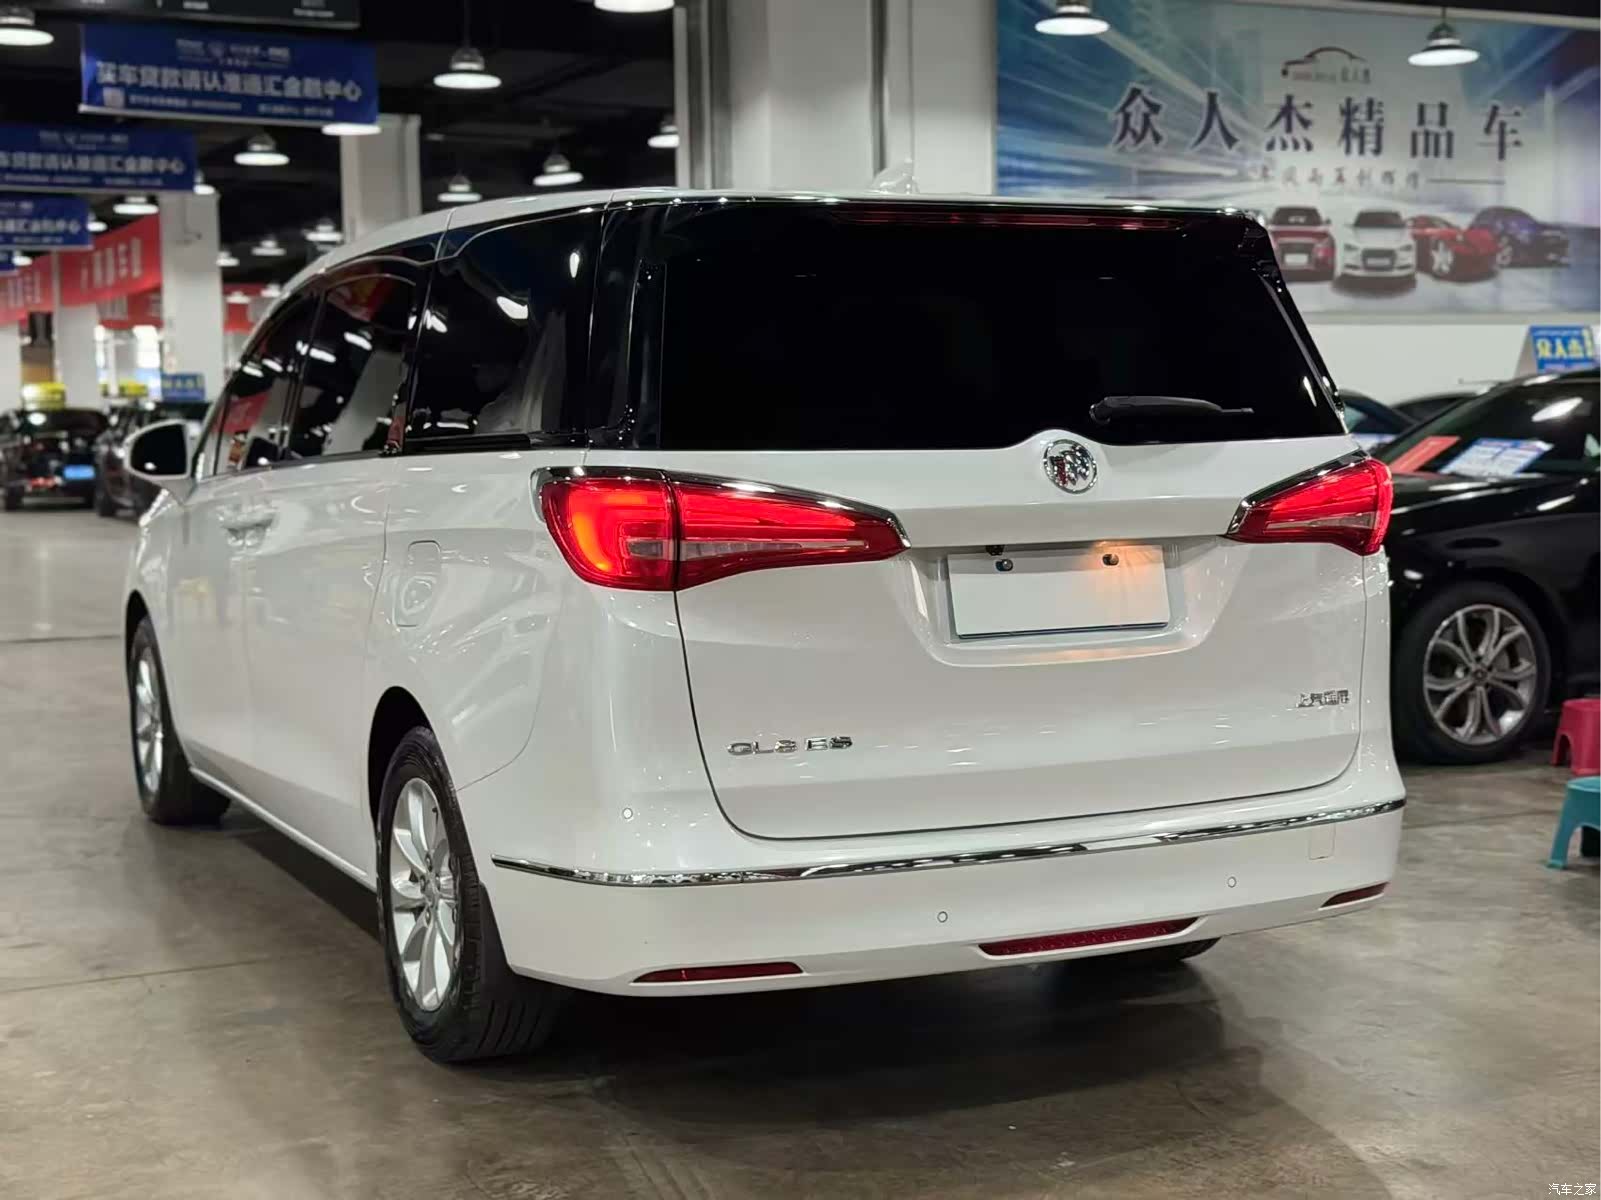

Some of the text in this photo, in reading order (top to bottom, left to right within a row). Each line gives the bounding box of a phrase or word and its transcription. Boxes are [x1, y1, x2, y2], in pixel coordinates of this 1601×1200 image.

[1113, 87, 1523, 161] 众人杰精品车
[727, 740, 797, 755] GL8
